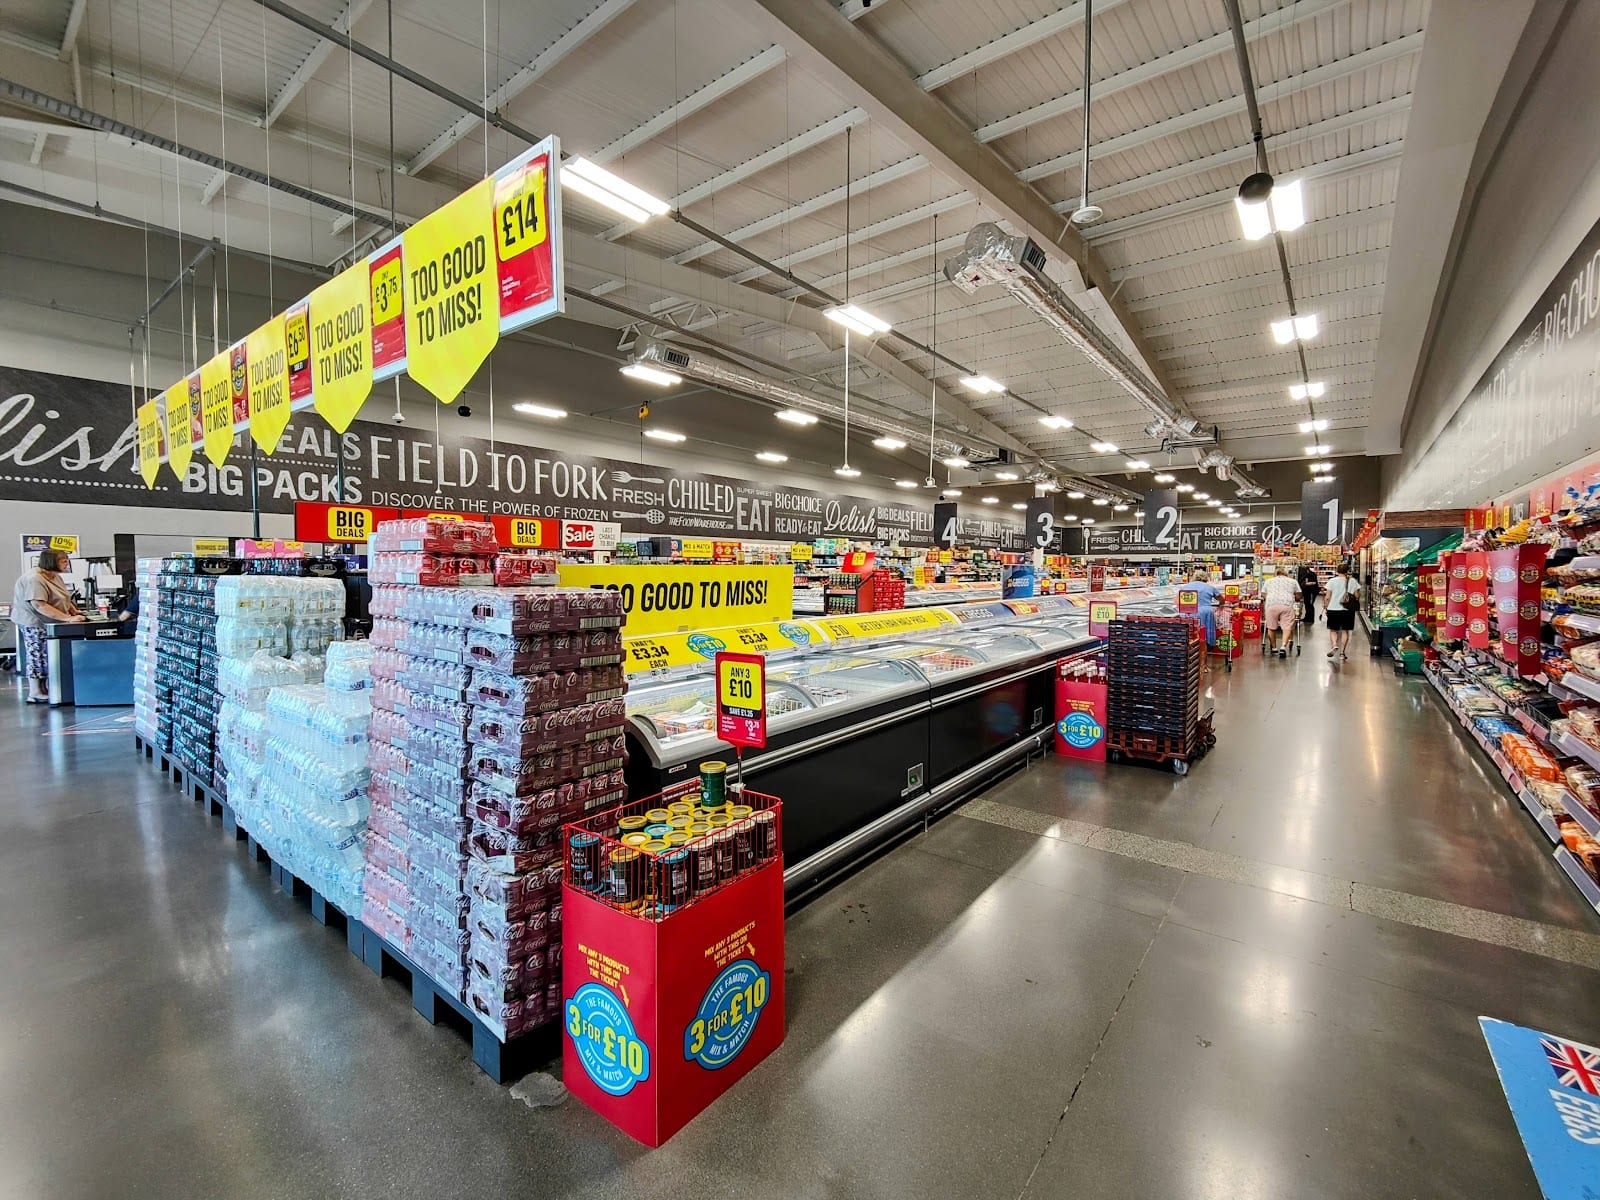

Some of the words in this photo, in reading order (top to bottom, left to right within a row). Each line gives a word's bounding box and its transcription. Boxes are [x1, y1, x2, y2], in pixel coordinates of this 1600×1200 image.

[502, 192, 538, 247] £14
[411, 260, 438, 306] TOO
[442, 235, 486, 291] GOOD
[375, 276, 397, 313] £3.75
[315, 319, 333, 353] TOO
[336, 303, 364, 343] GOOD
[417, 307, 435, 346] TO
[440, 284, 482, 338] MISS!
[1544, 290, 1566, 355] BIG
[288, 325, 305, 359] £6.50
[251, 361, 264, 388] TOO
[266, 349, 284, 380] GOOD
[319, 355, 331, 386] TO
[334, 341, 362, 381] MISS!
[203, 389, 213, 409] TOO
[214, 379, 228, 406] GOOD
[253, 388, 262, 415] TO
[263, 379, 283, 410] MISS!
[168, 408, 176, 429] TOO
[176, 402, 188, 425] GOOD
[205, 411, 213, 433] TO
[213, 405, 229, 430] MISS!
[170, 431, 178, 449] TO
[177, 425, 189, 446] MISS!
[257, 424, 362, 461] EALS
[371, 435, 478, 487] FIELD
[486, 452, 526, 494] TO
[534, 459, 607, 500] FORK
[182, 461, 243, 496] BIG
[257, 467, 363, 505] PACKS
[612, 487, 664, 507] FRESH
[668, 478, 734, 513] CHILLED
[372, 490, 454, 510] DISCOVER
[459, 498, 489, 512] THE
[493, 501, 541, 517] POWER
[544, 505, 560, 518] OF
[564, 507, 609, 521] FROZEN
[737, 497, 772, 532] EAT
[775, 492, 791, 510] BIG
[791, 494, 822, 513] CHOICE
[823, 500, 877, 533] Delish
[877, 506, 889, 521] BIG
[889, 508, 910, 522] DEALS
[336, 510, 364, 528] BIG
[336, 528, 364, 538] DEALS
[517, 521, 536, 535] BIG
[775, 517, 803, 535] READY
[808, 521, 822, 536] EAT
[877, 527, 889, 540] BIG
[889, 528, 910, 541] PACKS
[910, 511, 934, 532] FIELD
[941, 516, 957, 546] 4
[1036, 512, 1054, 547] 3
[1155, 506, 1178, 544] 2
[1204, 526, 1220, 537] BIG
[1221, 526, 1257, 536] CHOICE
[1322, 498, 1339, 545] 1
[566, 526, 594, 543] Sale
[1204, 540, 1233, 550] READY
[1240, 540, 1256, 550] EAT
[641, 582, 694, 613] GOOD
[700, 581, 721, 608] TO
[726, 579, 768, 607] MISS!
[1096, 611, 1110, 619] £10
[630, 639, 655, 648] THAT'S
[739, 632, 768, 645] £3.34
[830, 625, 850, 637] £10
[632, 645, 669, 660] £3.34
[649, 658, 668, 669] EACH
[730, 667, 744, 678] ANY
[745, 669, 751, 679] 3
[729, 678, 752, 699] £10
[1060, 721, 1067, 734] 3
[1068, 725, 1078, 733] FOR
[1079, 724, 1101, 738] £10
[705, 946, 714, 958] MIX
[715, 939, 726, 954] ANY
[726, 936, 730, 944] 3
[730, 920, 756, 942] PRODUCTS
[714, 947, 728, 961] WITH
[728, 940, 740, 953] THIS
[739, 934, 748, 944] ON
[578, 943, 588, 955] MIX
[587, 947, 598, 958] ANY
[602, 955, 630, 976] PRODUCTS
[586, 956, 600, 970] WITH
[599, 963, 612, 976] THIS
[611, 970, 621, 981] ON
[716, 957, 727, 968] THE
[727, 945, 746, 962] TICKET
[589, 966, 600, 979] THE
[600, 973, 618, 989] TICKET
[711, 984, 725, 1003] THE
[724, 972, 749, 990] FAMOUS
[585, 996, 597, 1009] THE
[597, 998, 622, 1027] FAMOUS
[690, 1019, 705, 1054] 3
[707, 1009, 728, 1037] FOR
[730, 976, 766, 1027] £10
[569, 1004, 580, 1037] 3
[582, 1019, 601, 1045] FOR
[603, 1025, 643, 1076] £10
[709, 1043, 722, 1056] MIX
[722, 1045, 728, 1054] &
[729, 1020, 749, 1049] MATCH
[584, 1049, 596, 1066] MIX
[603, 1068, 624, 1081] MATCH
